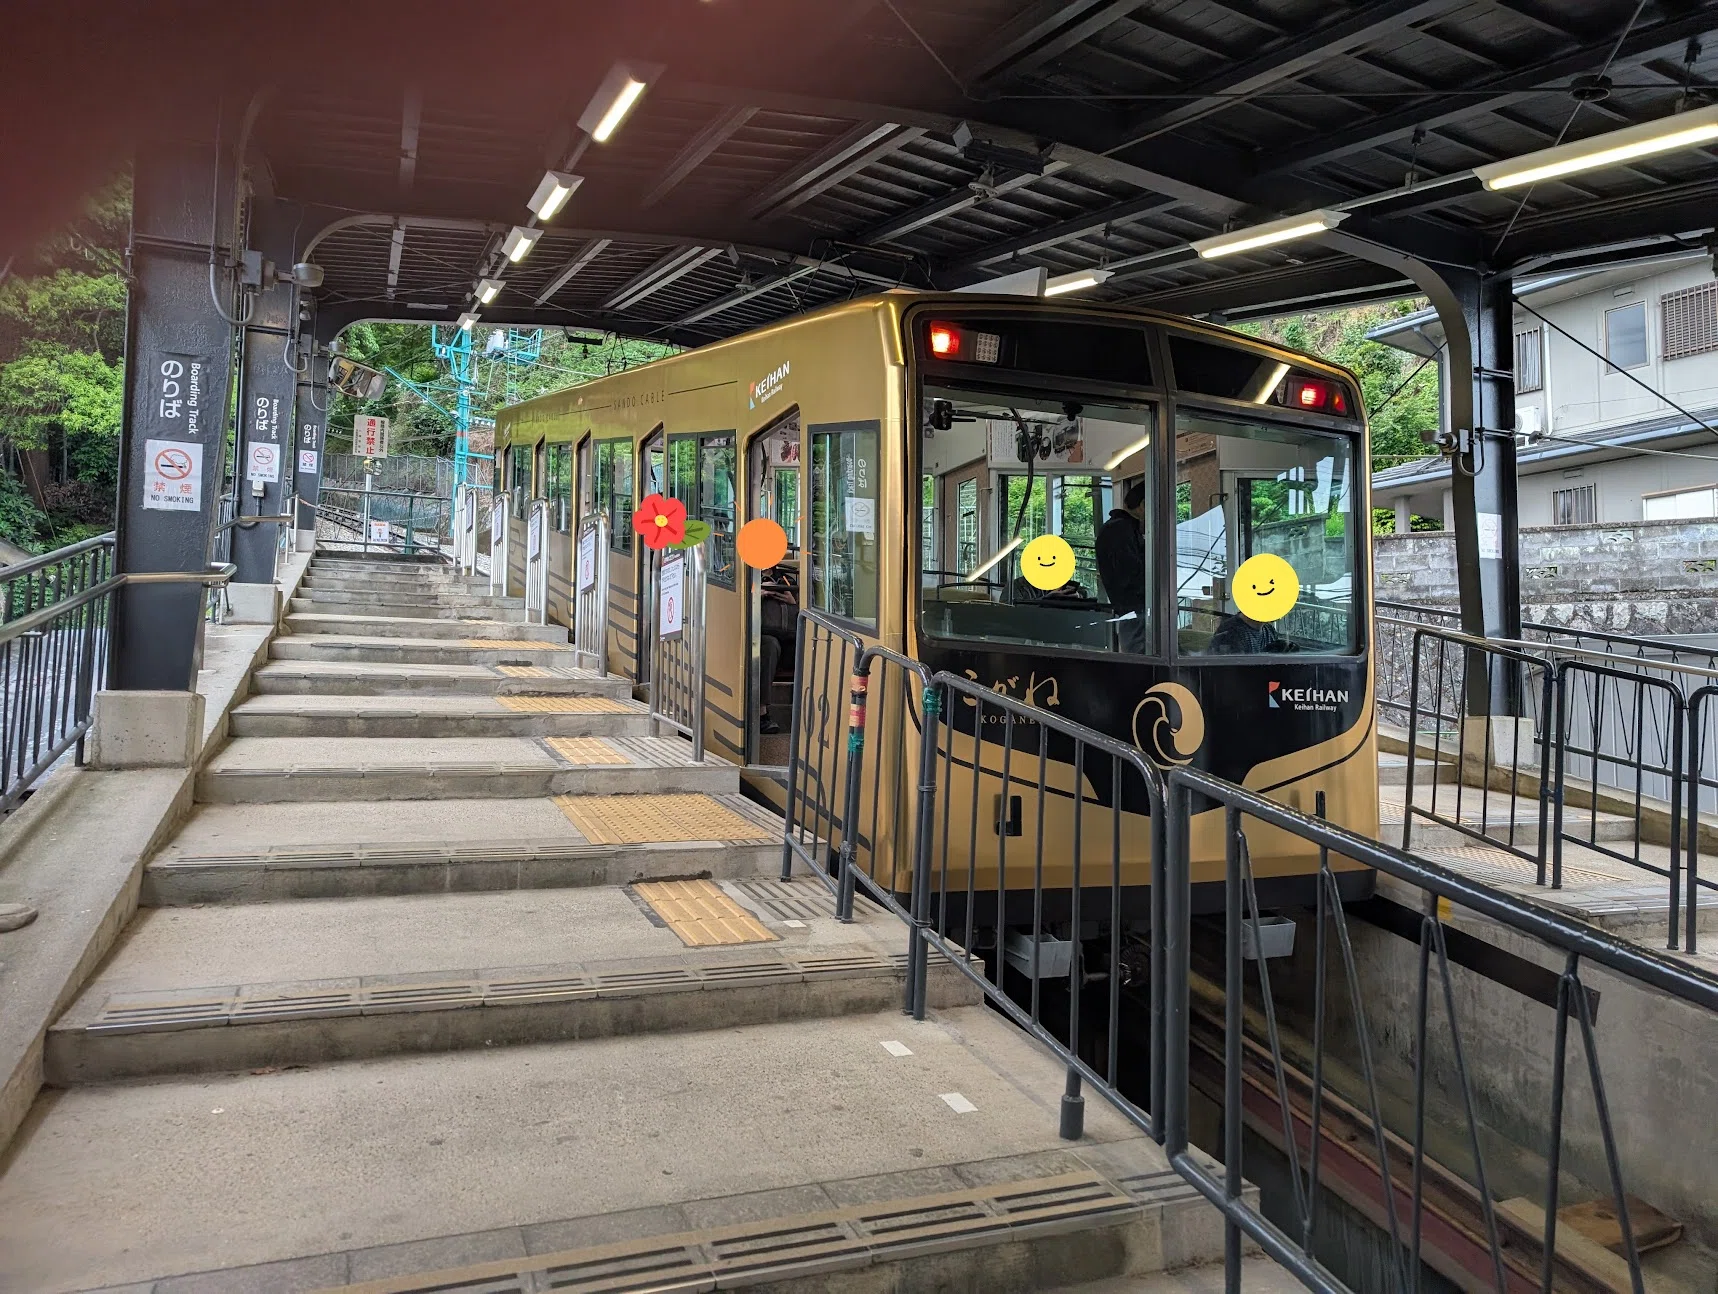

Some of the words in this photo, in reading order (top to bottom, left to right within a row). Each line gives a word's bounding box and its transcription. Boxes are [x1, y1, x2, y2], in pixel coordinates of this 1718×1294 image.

[160, 360, 183, 418] のりば
[187, 363, 201, 406] Boarding
[755, 360, 790, 398] KEIHAN
[256, 397, 269, 430] のりば
[613, 395, 636, 411] SANDO
[640, 389, 665, 406] CABLE
[188, 409, 199, 434] Track
[366, 418, 376, 455] 通行禁止
[153, 481, 192, 494] 禁煙
[1281, 688, 1349, 702] KEIHAN
[1294, 703, 1314, 711] Keihan
[1315, 704, 1337, 713] Railway
